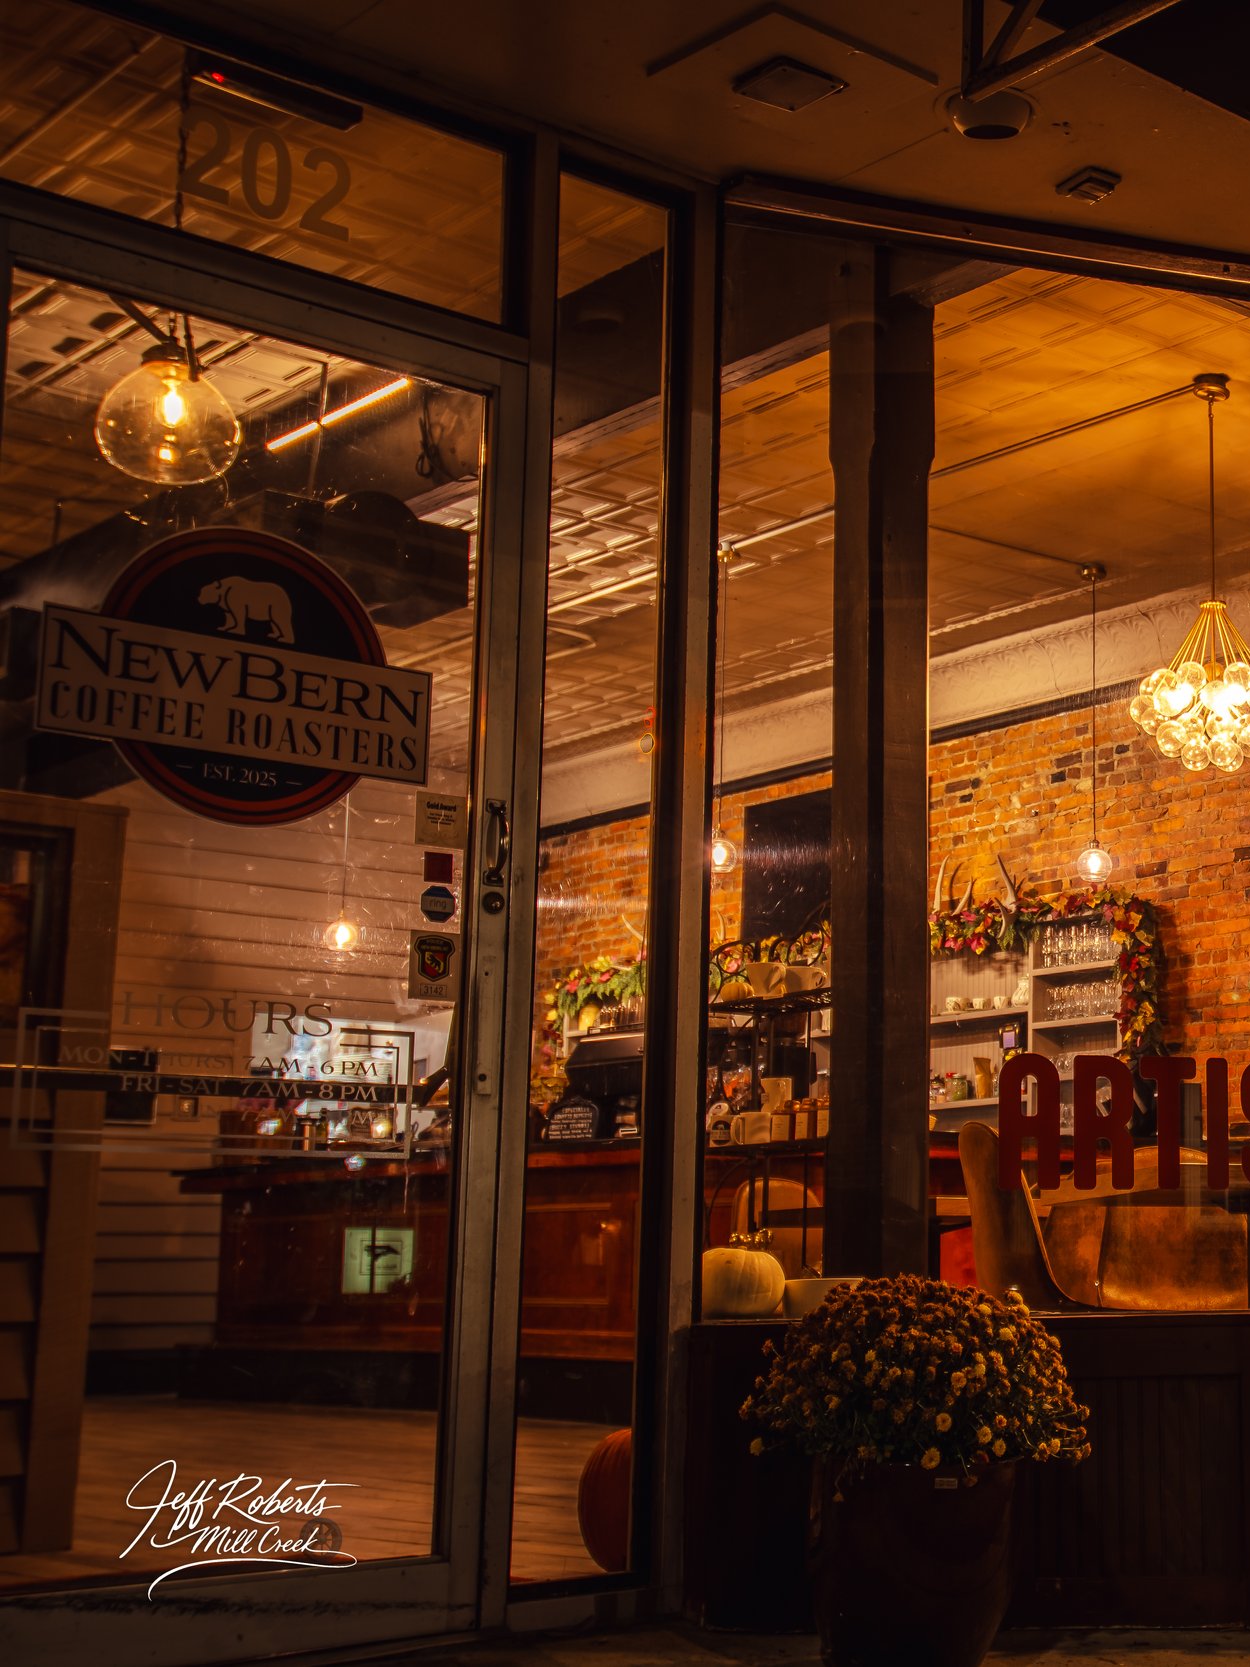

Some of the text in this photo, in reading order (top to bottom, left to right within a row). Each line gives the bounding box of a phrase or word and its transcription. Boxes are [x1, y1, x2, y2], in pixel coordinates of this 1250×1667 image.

[181, 111, 351, 242] 202
[49, 680, 418, 772] COFFEE ROASTERS
[203, 762, 277, 788] EST. 2025
[423, 985, 444, 995] 3142
[121, 990, 333, 1037] HOURS
[120, 1074, 161, 1093] FRI
[178, 1077, 226, 1096] SAT
